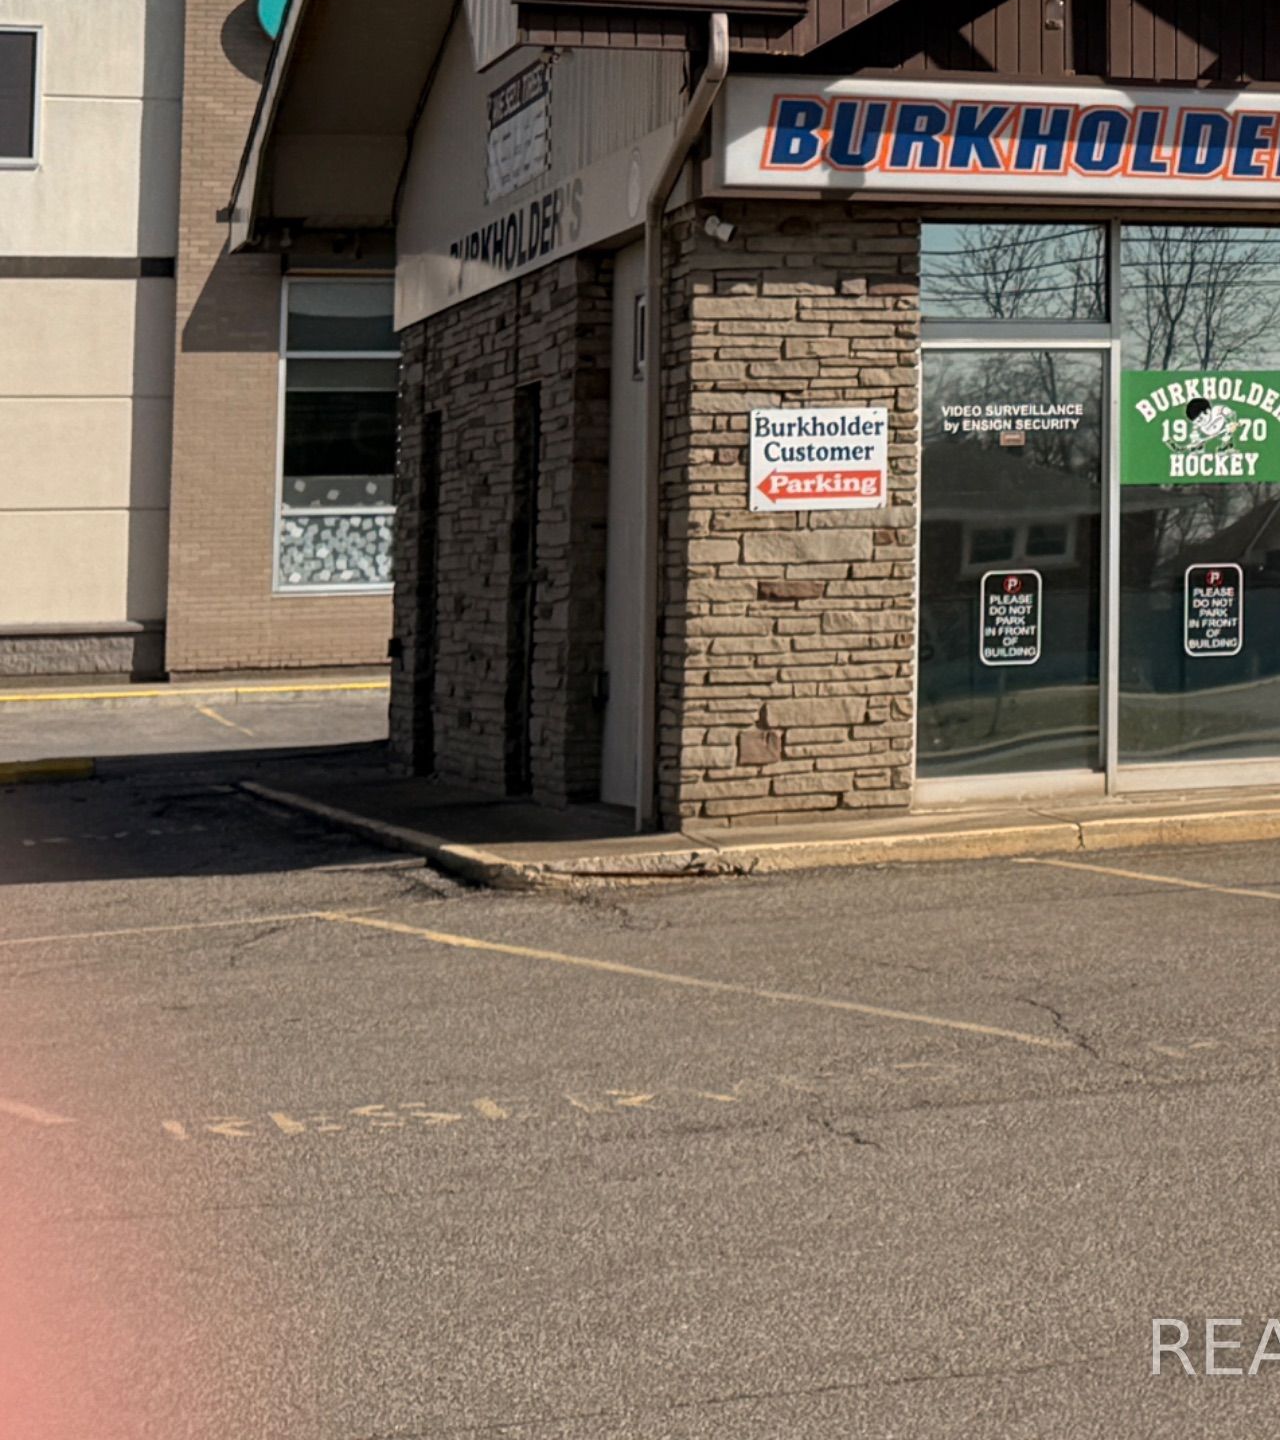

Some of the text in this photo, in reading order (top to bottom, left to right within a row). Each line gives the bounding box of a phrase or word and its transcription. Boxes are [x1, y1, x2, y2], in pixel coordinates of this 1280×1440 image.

[941, 403, 1084, 417] VIDEO SURVEILLANCE
[754, 415, 884, 437] Burkholder
[944, 418, 1080, 434] by ENSIGN SECURITY
[1161, 418, 1267, 442] 19 70
[764, 441, 874, 462] Customer
[1169, 452, 1259, 477] HOCKEY
[768, 473, 878, 496] Parking
[1193, 587, 1234, 597] PLEASE
[989, 594, 1033, 605] PLEASE
[1193, 598, 1233, 608] DO NOT
[988, 605, 1032, 616] DO NOT
[1199, 609, 1227, 617] PARK
[995, 616, 1026, 625] PARK
[1189, 618, 1237, 628] IN FRONT
[985, 625, 1036, 636] IN FRONT
[1206, 629, 1221, 638] OF
[1002, 637, 1019, 646] OF
[1189, 638, 1237, 649] BUILDING
[984, 646, 1036, 658] BUILDING
